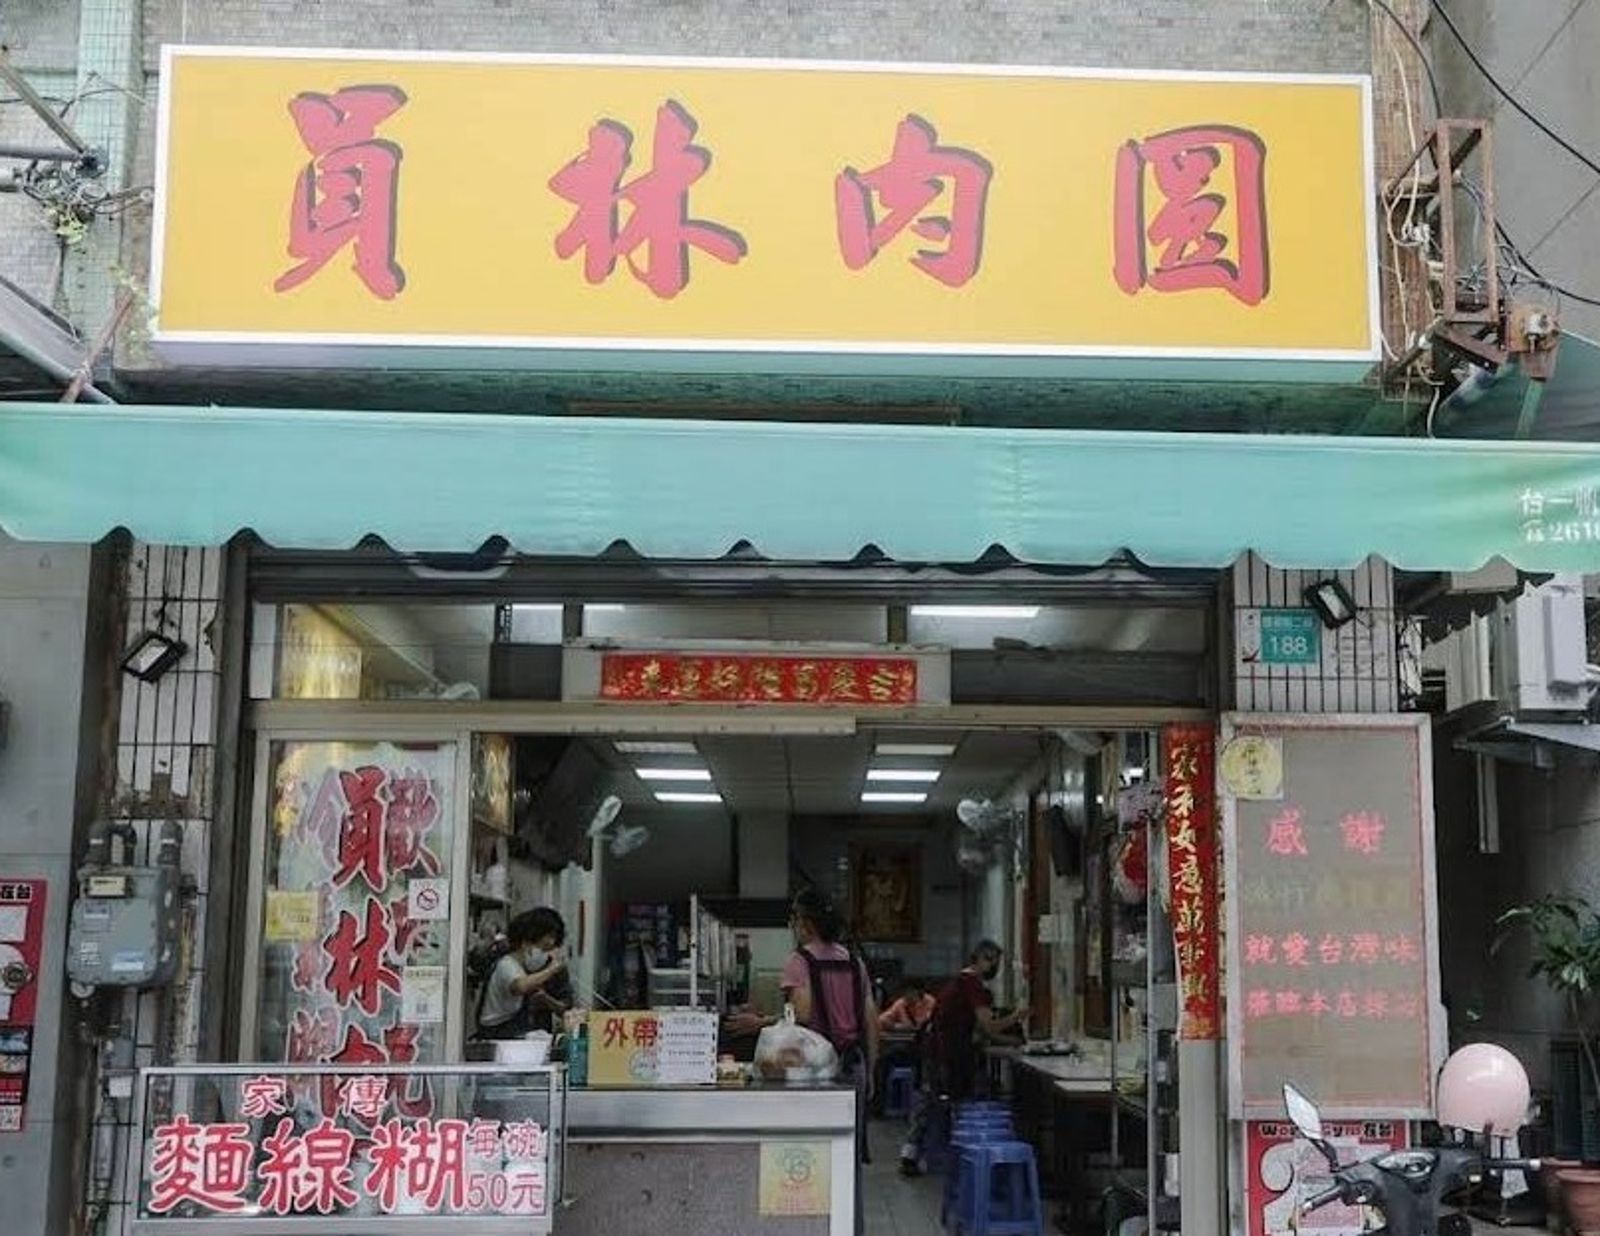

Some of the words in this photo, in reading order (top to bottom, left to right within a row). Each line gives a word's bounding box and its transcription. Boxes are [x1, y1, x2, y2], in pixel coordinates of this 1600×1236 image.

[273, 84, 1270, 306] 員林肉圓
[1269, 636, 1308, 655] 188
[1264, 806, 1386, 857] 感謝
[319, 764, 402, 1140] 員林肉
[603, 1016, 659, 1048] 外帶
[242, 1075, 389, 1117] 家傳
[468, 1117, 543, 1160] 每碗
[149, 1114, 468, 1214] 麵線糊
[468, 1172, 543, 1209] 50元
